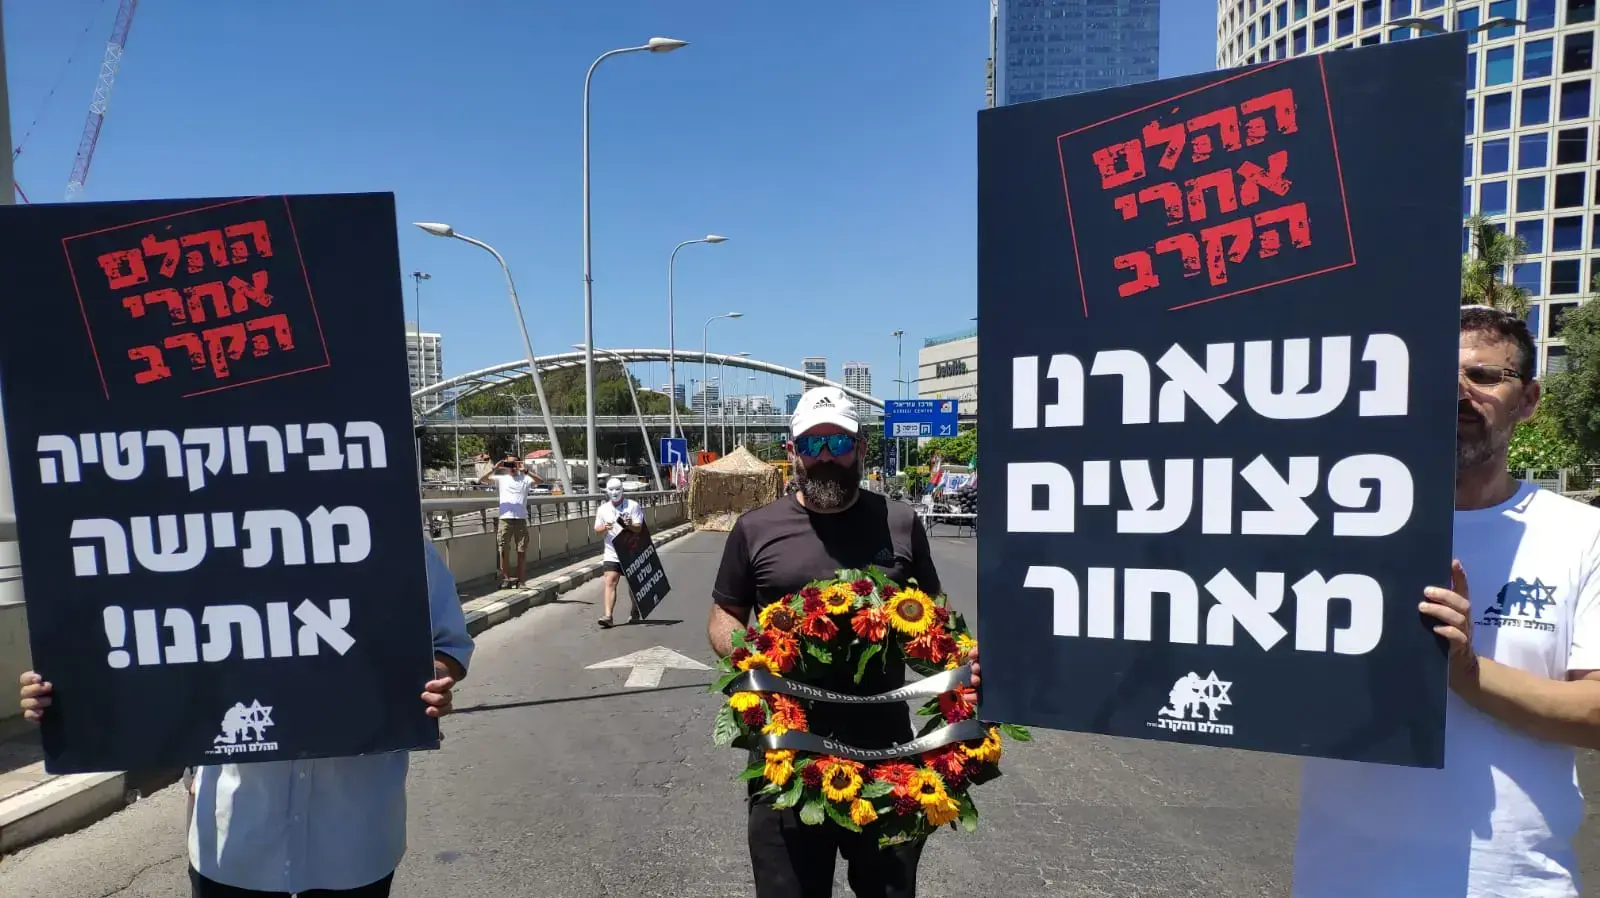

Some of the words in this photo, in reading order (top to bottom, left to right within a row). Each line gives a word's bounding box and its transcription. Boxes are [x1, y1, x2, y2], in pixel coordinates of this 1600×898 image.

[1092, 88, 1299, 189] ההלם
[1113, 150, 1292, 227] אחרי
[97, 219, 274, 290] ההלם
[1113, 202, 1312, 298] הקרב
[121, 269, 274, 326] אחרי
[127, 313, 295, 385] הקרב
[1012, 333, 1410, 430] נשארנו
[813, 402, 836, 410] adidas
[37, 420, 388, 492] הבירוקרטיה
[1007, 453, 1414, 537] פצועים
[69, 505, 372, 576] מתישה
[625, 544, 655, 577] המשפחה
[636, 563, 653, 583] שלנו
[103, 598, 356, 669] אותנו!
[1023, 565, 1384, 656] מאחור
[786, 680, 823, 697] אחינו
[248, 741, 278, 752] ההלם
[1198, 721, 1234, 735] ההלם
